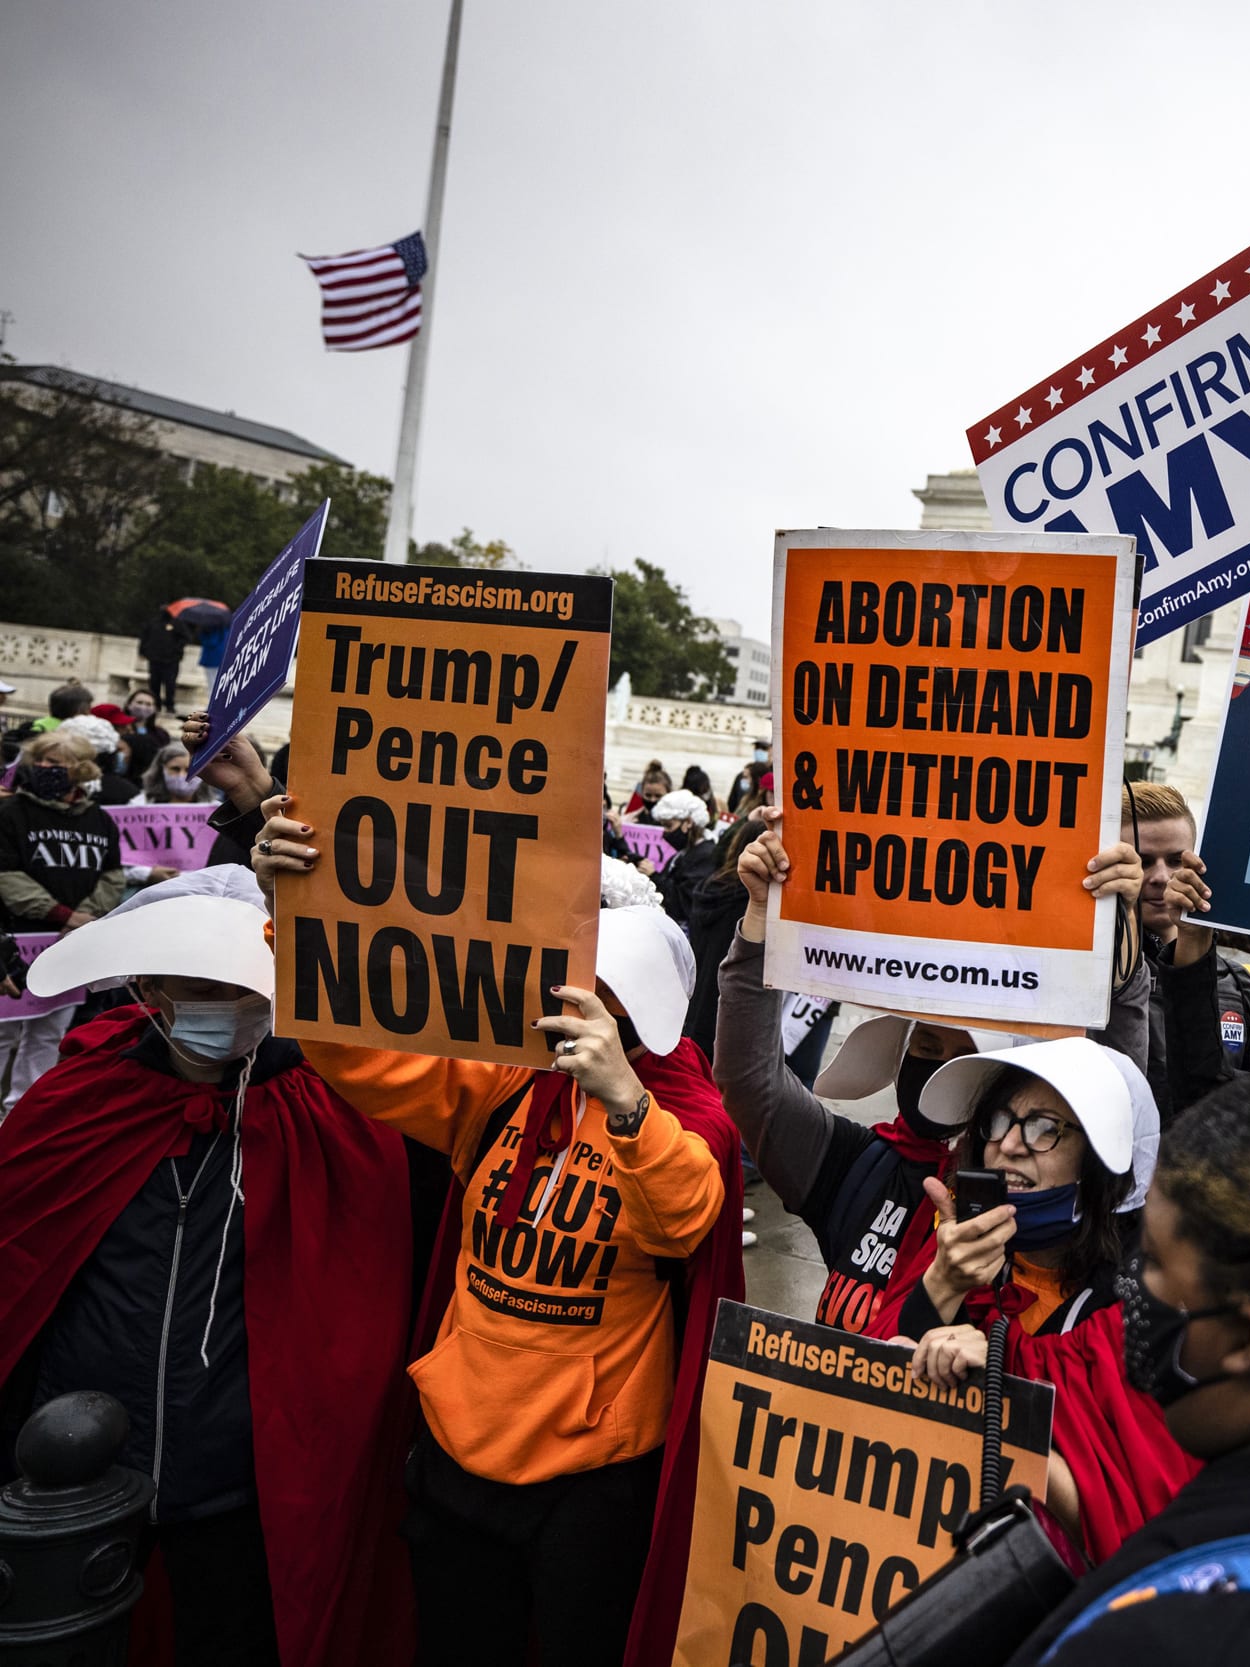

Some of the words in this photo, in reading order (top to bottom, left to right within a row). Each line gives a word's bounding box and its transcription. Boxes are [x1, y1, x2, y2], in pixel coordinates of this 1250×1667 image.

[335, 572, 575, 620] RefuseFascism.org
[814, 580, 1085, 654] ABORTION
[215, 616, 272, 700] PROTECT
[270, 582, 303, 635] LIFE
[225, 672, 242, 709] IN
[241, 638, 273, 691] LAW
[326, 624, 579, 724] Trump/
[794, 661, 853, 726] ON
[866, 664, 1093, 739] DEMAND
[331, 707, 548, 795] Pence
[792, 752, 824, 810] &
[836, 749, 1087, 829] WITHOUT
[32, 842, 108, 871] AMY
[120, 826, 202, 851] AMY
[334, 795, 539, 923] OUT
[815, 830, 1046, 911] APOLOGY
[294, 916, 569, 1052] NOW!
[804, 946, 1039, 990] www.revcom.us
[1224, 1030, 1241, 1040] AMY
[472, 1209, 619, 1290] NOW!
[851, 1233, 898, 1279] Spe
[470, 1272, 596, 1320] RefuseFascism.org
[732, 1486, 920, 1622] Penc
